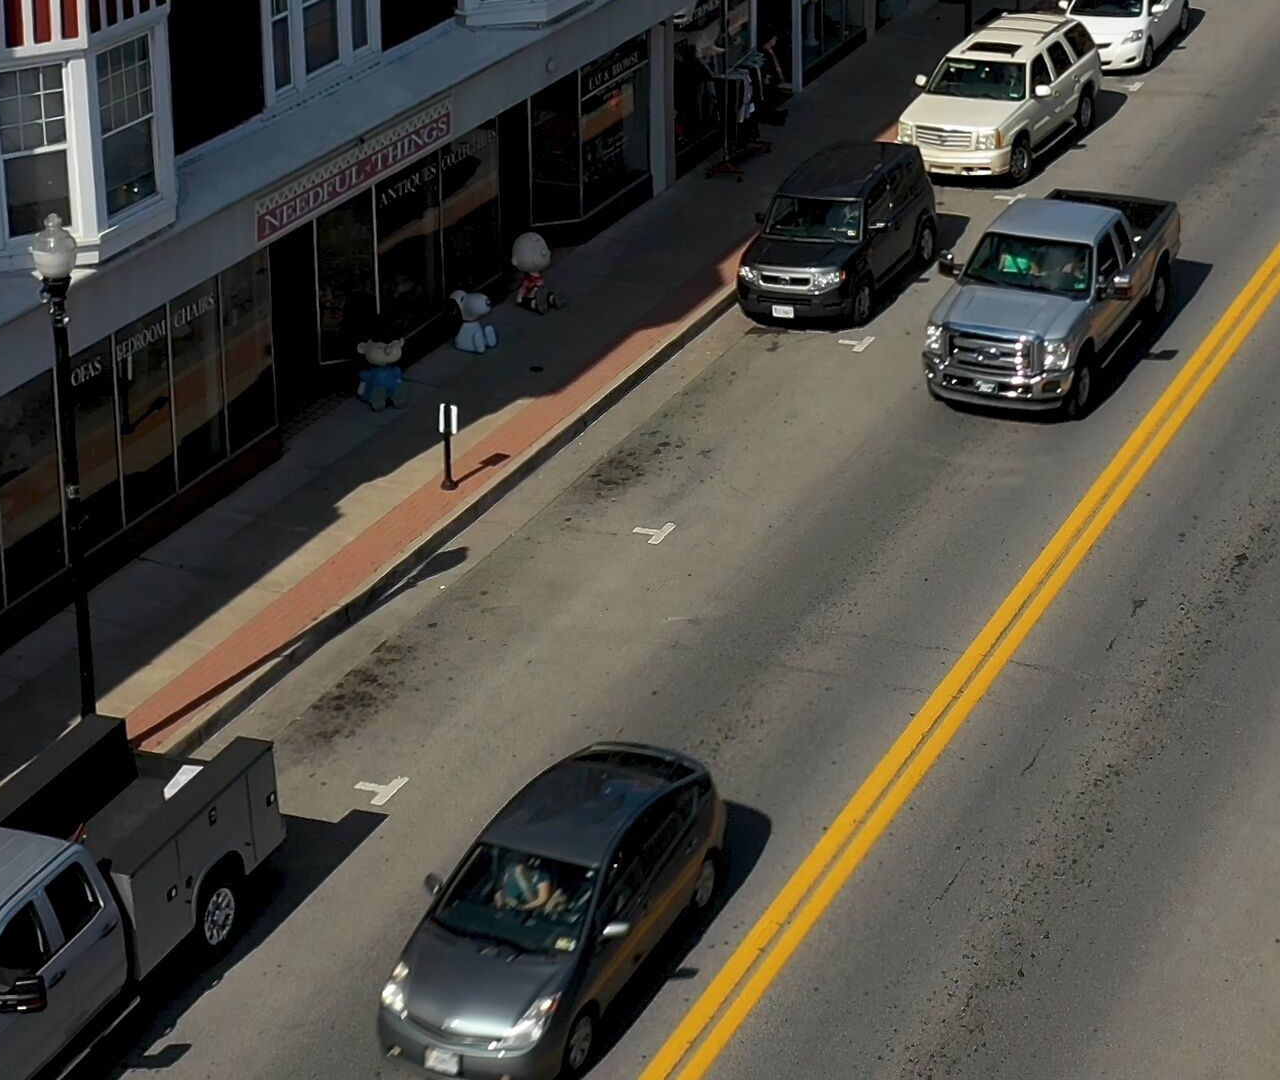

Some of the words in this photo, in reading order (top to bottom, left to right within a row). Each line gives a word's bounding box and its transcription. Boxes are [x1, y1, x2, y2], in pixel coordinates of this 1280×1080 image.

[263, 165, 365, 236] NEEDFUL
[371, 118, 448, 173] THINGS
[70, 354, 103, 387] OFAS
[174, 291, 217, 328] CHAIRS
[379, 161, 437, 208] ANTIQUES
